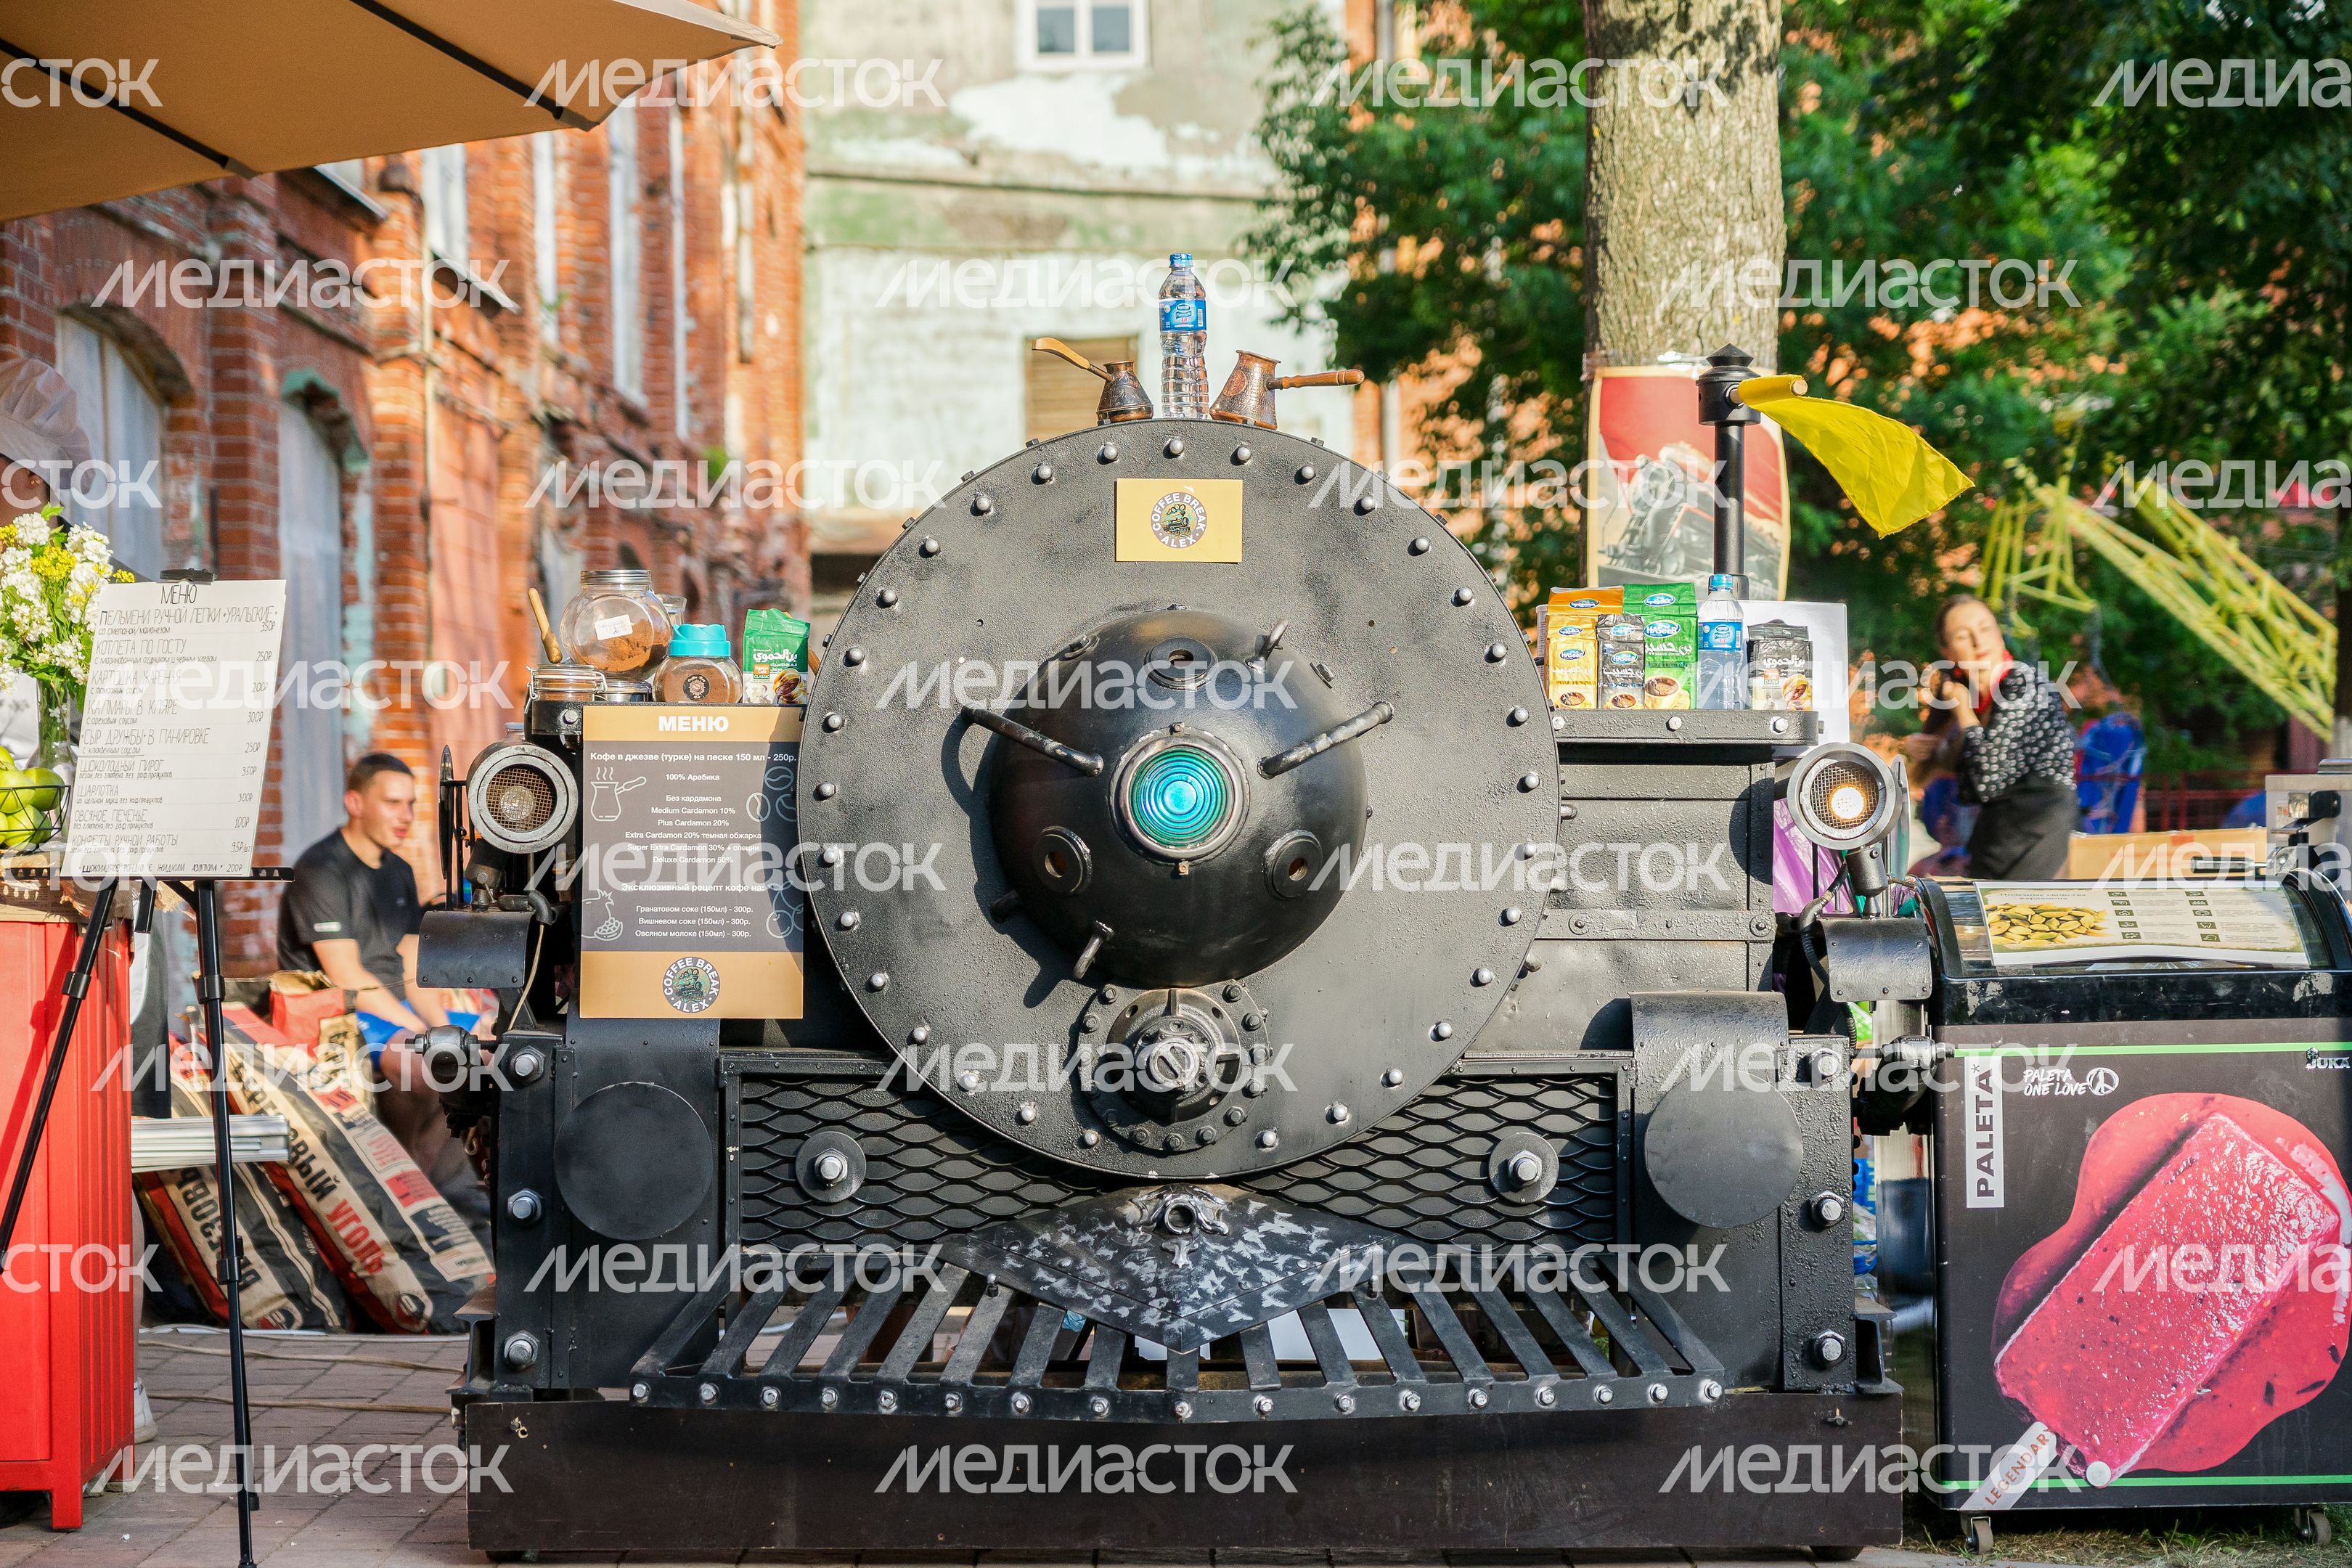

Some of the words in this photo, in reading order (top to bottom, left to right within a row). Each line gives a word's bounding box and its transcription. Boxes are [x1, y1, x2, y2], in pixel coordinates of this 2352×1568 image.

[1151, 492, 1180, 531] COFFEE
[1183, 494, 1206, 531] BREAK
[1161, 534, 1196, 547] ALEX
[160, 584, 197, 604] МЕНЮ
[96, 639, 136, 655] КОТЛЕТА
[140, 639, 153, 655] ПО
[157, 638, 187, 654] ГОСТУ
[658, 715, 729, 732] МЕНЮ
[590, 752, 615, 761] Кофе
[661, 752, 692, 761] (турке)
[77, 785, 118, 797] ШАРЛОТКА
[74, 809, 107, 822] ОВСЯНОЕ
[111, 809, 147, 822] ПЕЧЕНЬЕ
[729, 831, 761, 840] обжарка
[626, 844, 648, 852] Super
[621, 883, 690, 891] Эксклюзивный
[691, 884, 723, 893] рецепт
[724, 883, 750, 893] кофе
[733, 905, 754, 914] 300р.
[731, 918, 751, 926] 300р.
[698, 929, 725, 938] (150мл)
[732, 930, 751, 939] 300р.
[663, 957, 693, 996] COFFEE
[695, 957, 719, 996] BREAK
[672, 999, 710, 1013] ALEX
[2023, 1069, 2073, 1082] PALETA
[2023, 1082, 2051, 1097] ONE
[2054, 1082, 2088, 1096] LOVE
[325, 1198, 386, 1275] УГОЛЬ
